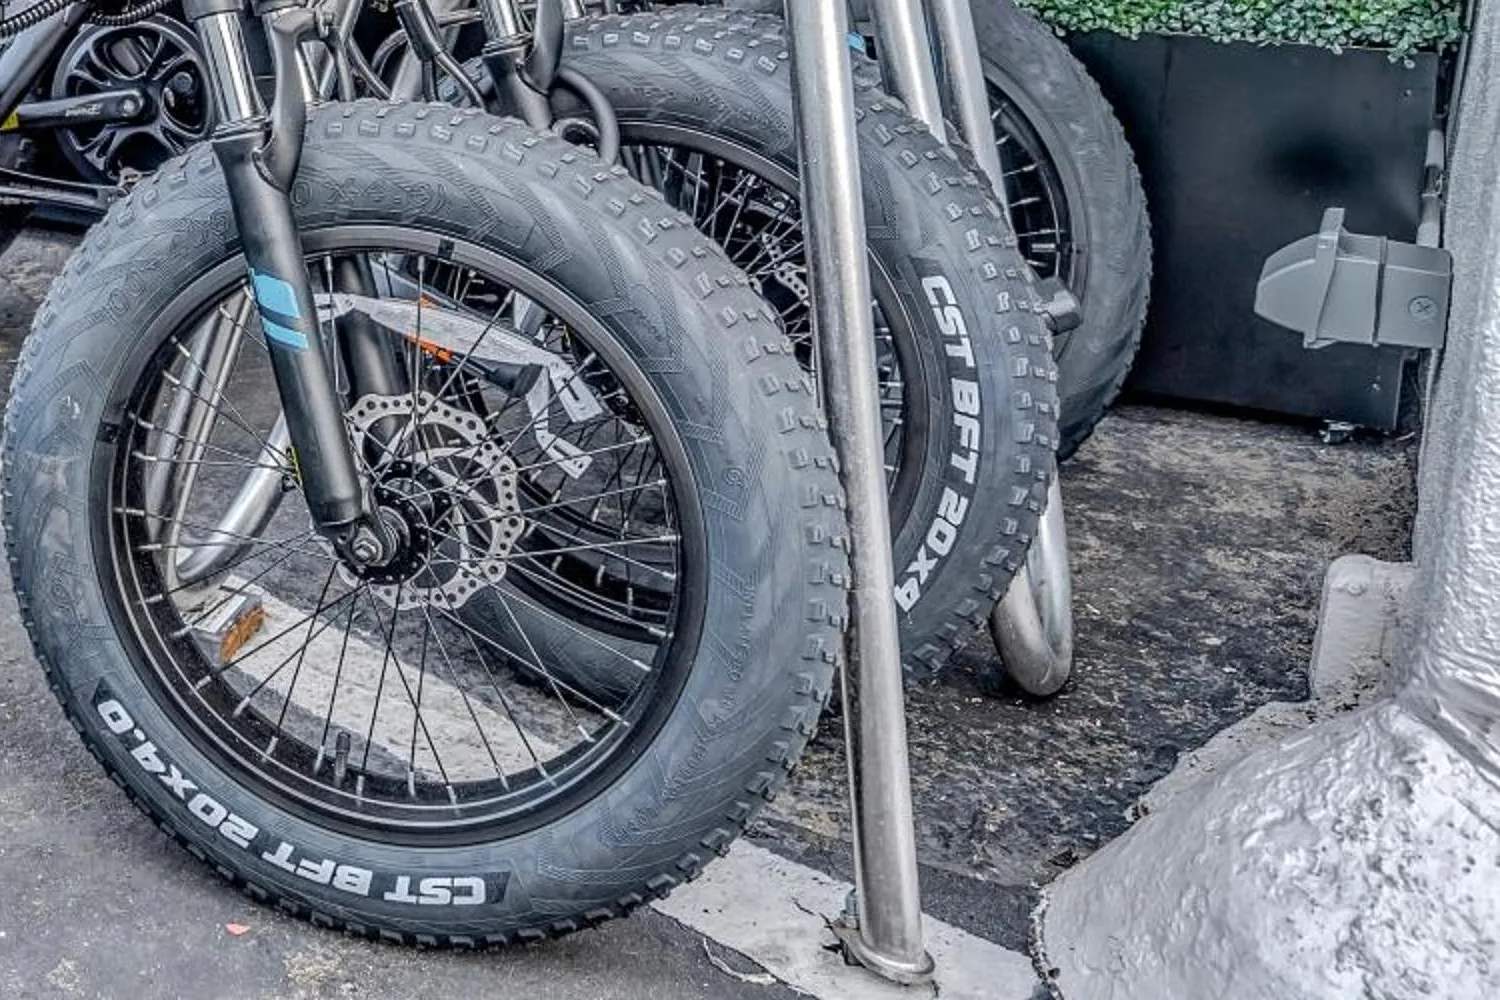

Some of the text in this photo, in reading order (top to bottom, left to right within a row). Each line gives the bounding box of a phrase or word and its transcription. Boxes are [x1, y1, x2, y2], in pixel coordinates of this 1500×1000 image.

[893, 275, 982, 613] CST BFT 20X4
[261, 841, 374, 897] BFT
[383, 874, 487, 906] CST
